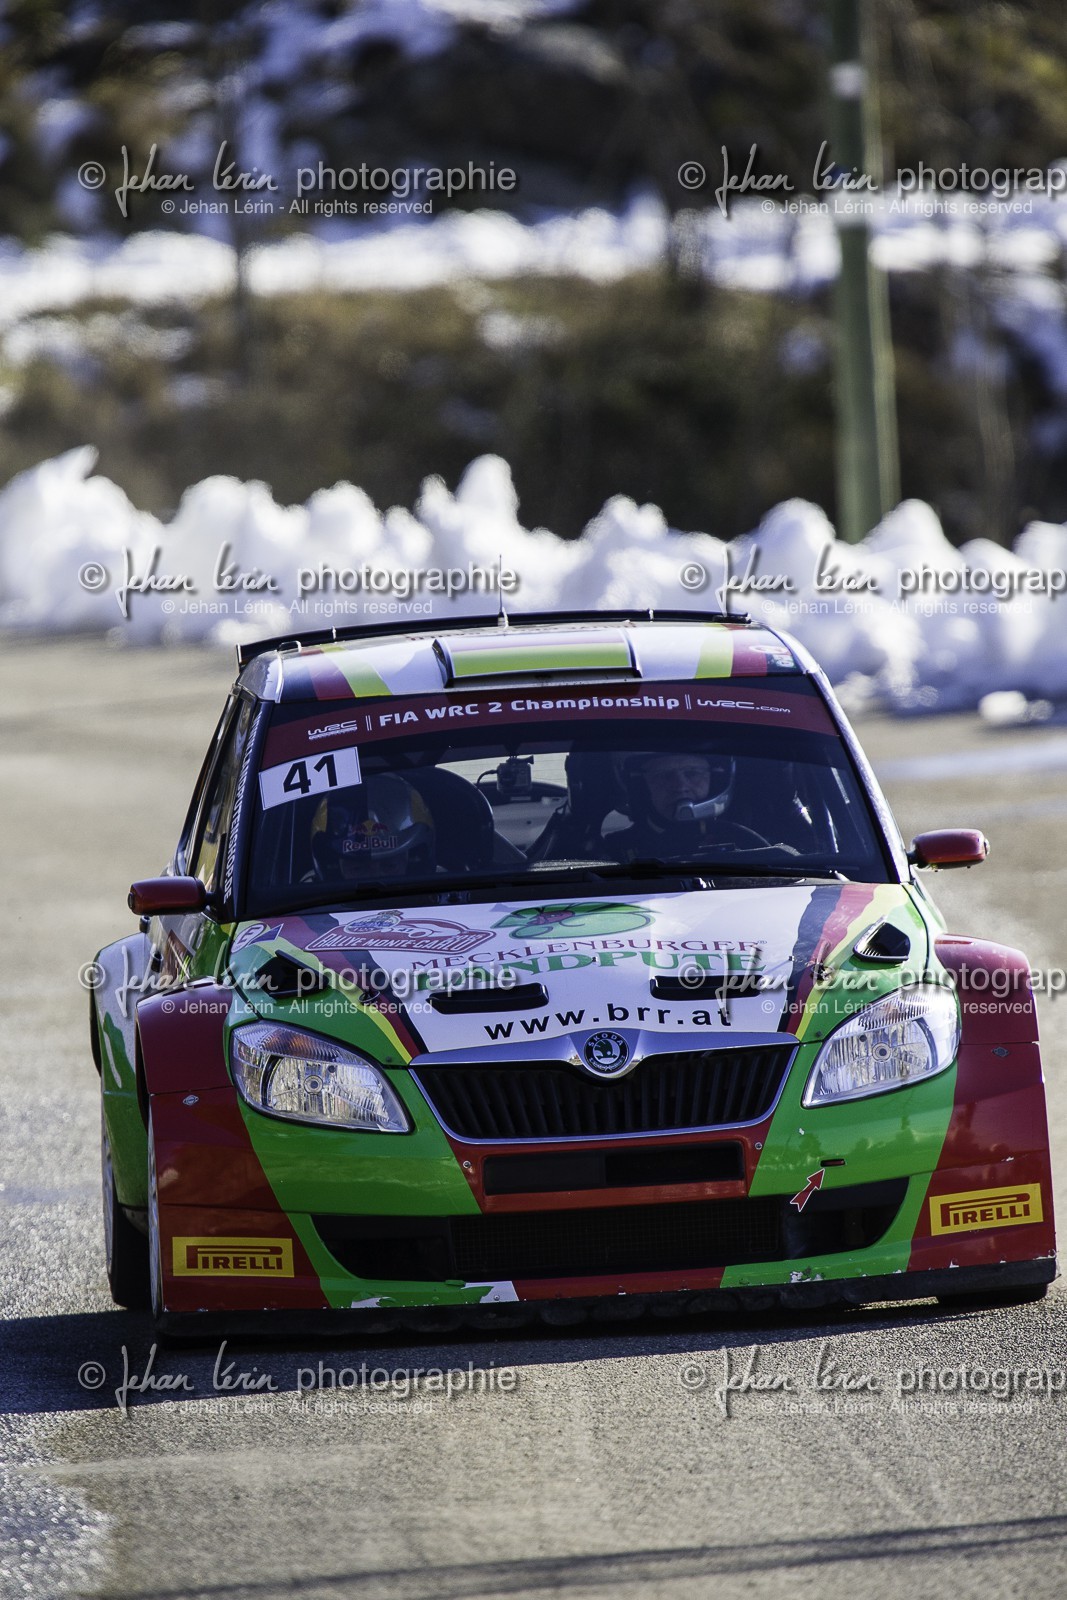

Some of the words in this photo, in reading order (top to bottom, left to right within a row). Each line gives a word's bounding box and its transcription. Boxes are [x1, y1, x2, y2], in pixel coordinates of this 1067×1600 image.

[379, 711, 419, 727] FIA
[425, 703, 479, 720] WRC
[488, 702, 502, 713] 2
[511, 696, 680, 711] Championship
[283, 754, 338, 795] 41
[343, 839, 369, 852] Red
[371, 836, 398, 849] Bull
[312, 933, 366, 948] RALLYE
[362, 936, 477, 951] MONTE-CARLO
[484, 1003, 731, 1041] www.brr.at
[940, 1193, 1030, 1227] PIRELLI
[185, 1245, 283, 1270] PIRELLI
